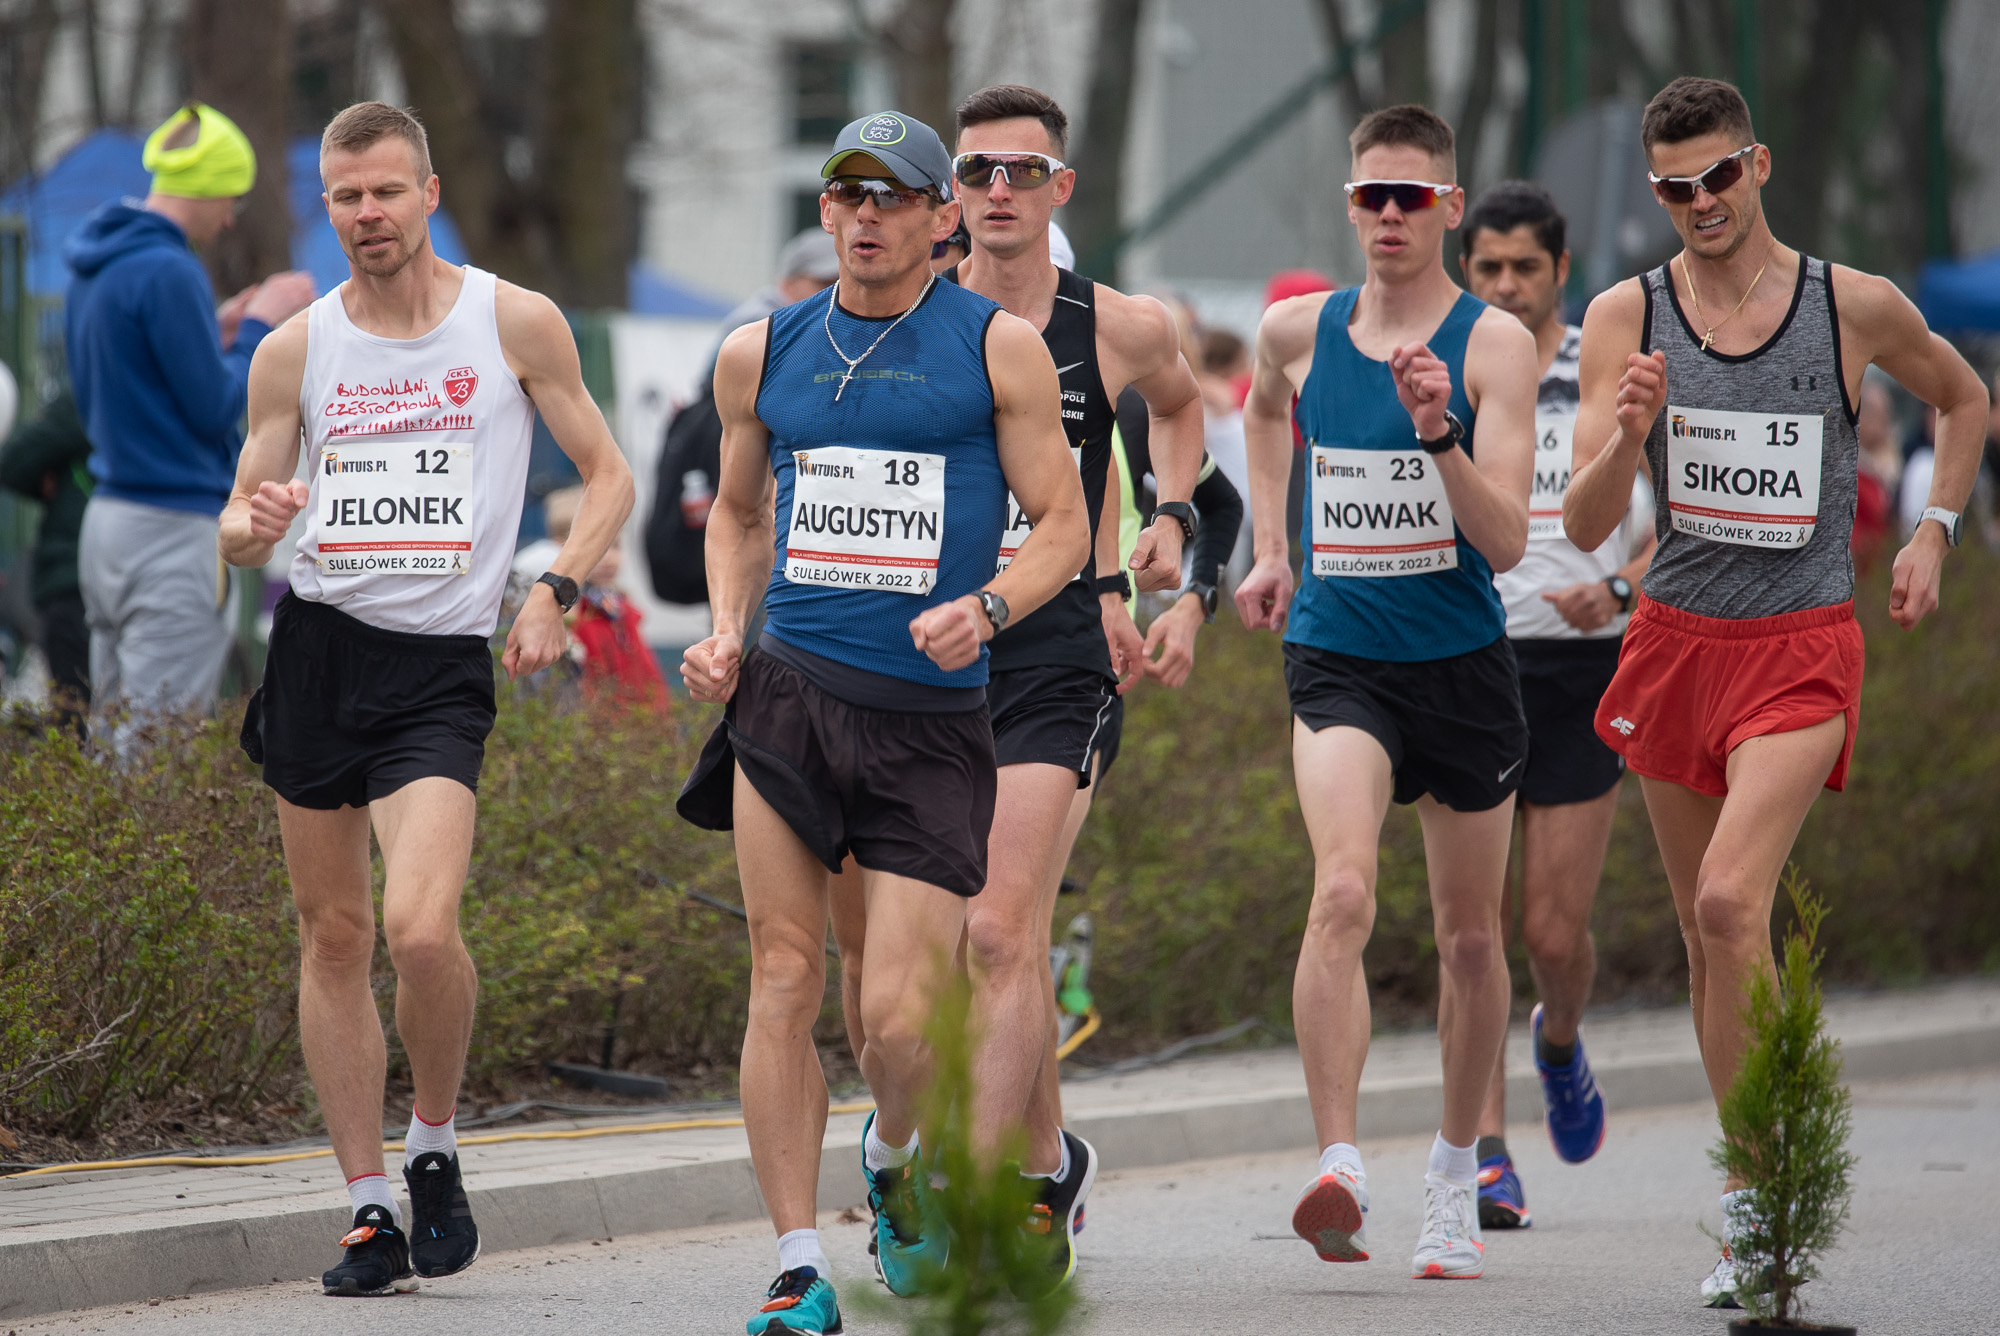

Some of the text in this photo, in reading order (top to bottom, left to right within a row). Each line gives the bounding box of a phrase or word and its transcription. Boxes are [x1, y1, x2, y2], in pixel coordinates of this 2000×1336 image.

[866, 130, 891, 140] 365
[450, 369, 469, 378] CKS
[1061, 409, 1085, 421] LSKIE
[1685, 425, 1737, 441] INTUIS.PL
[1765, 421, 1799, 447] 15
[338, 460, 388, 473] INTUIS.PL
[414, 449, 449, 474] 12
[808, 463, 855, 479] INTUIS.PL
[1326, 465, 1367, 479] INTUIS.PL
[1390, 457, 1425, 481] 23
[884, 459, 920, 486] 18
[1683, 461, 1802, 498] SIKORA
[325, 497, 464, 527] JELONEK
[793, 502, 938, 541] AUGUSTYN
[1323, 501, 1440, 529] NOWAK
[1678, 518, 1792, 543] SULEJÓWEK 2022
[329, 555, 446, 570] SULEJÓWEK 2022
[1320, 556, 1432, 572] SULEJÓWEK 2022
[792, 566, 912, 587] SULEJÓWEK 2022
